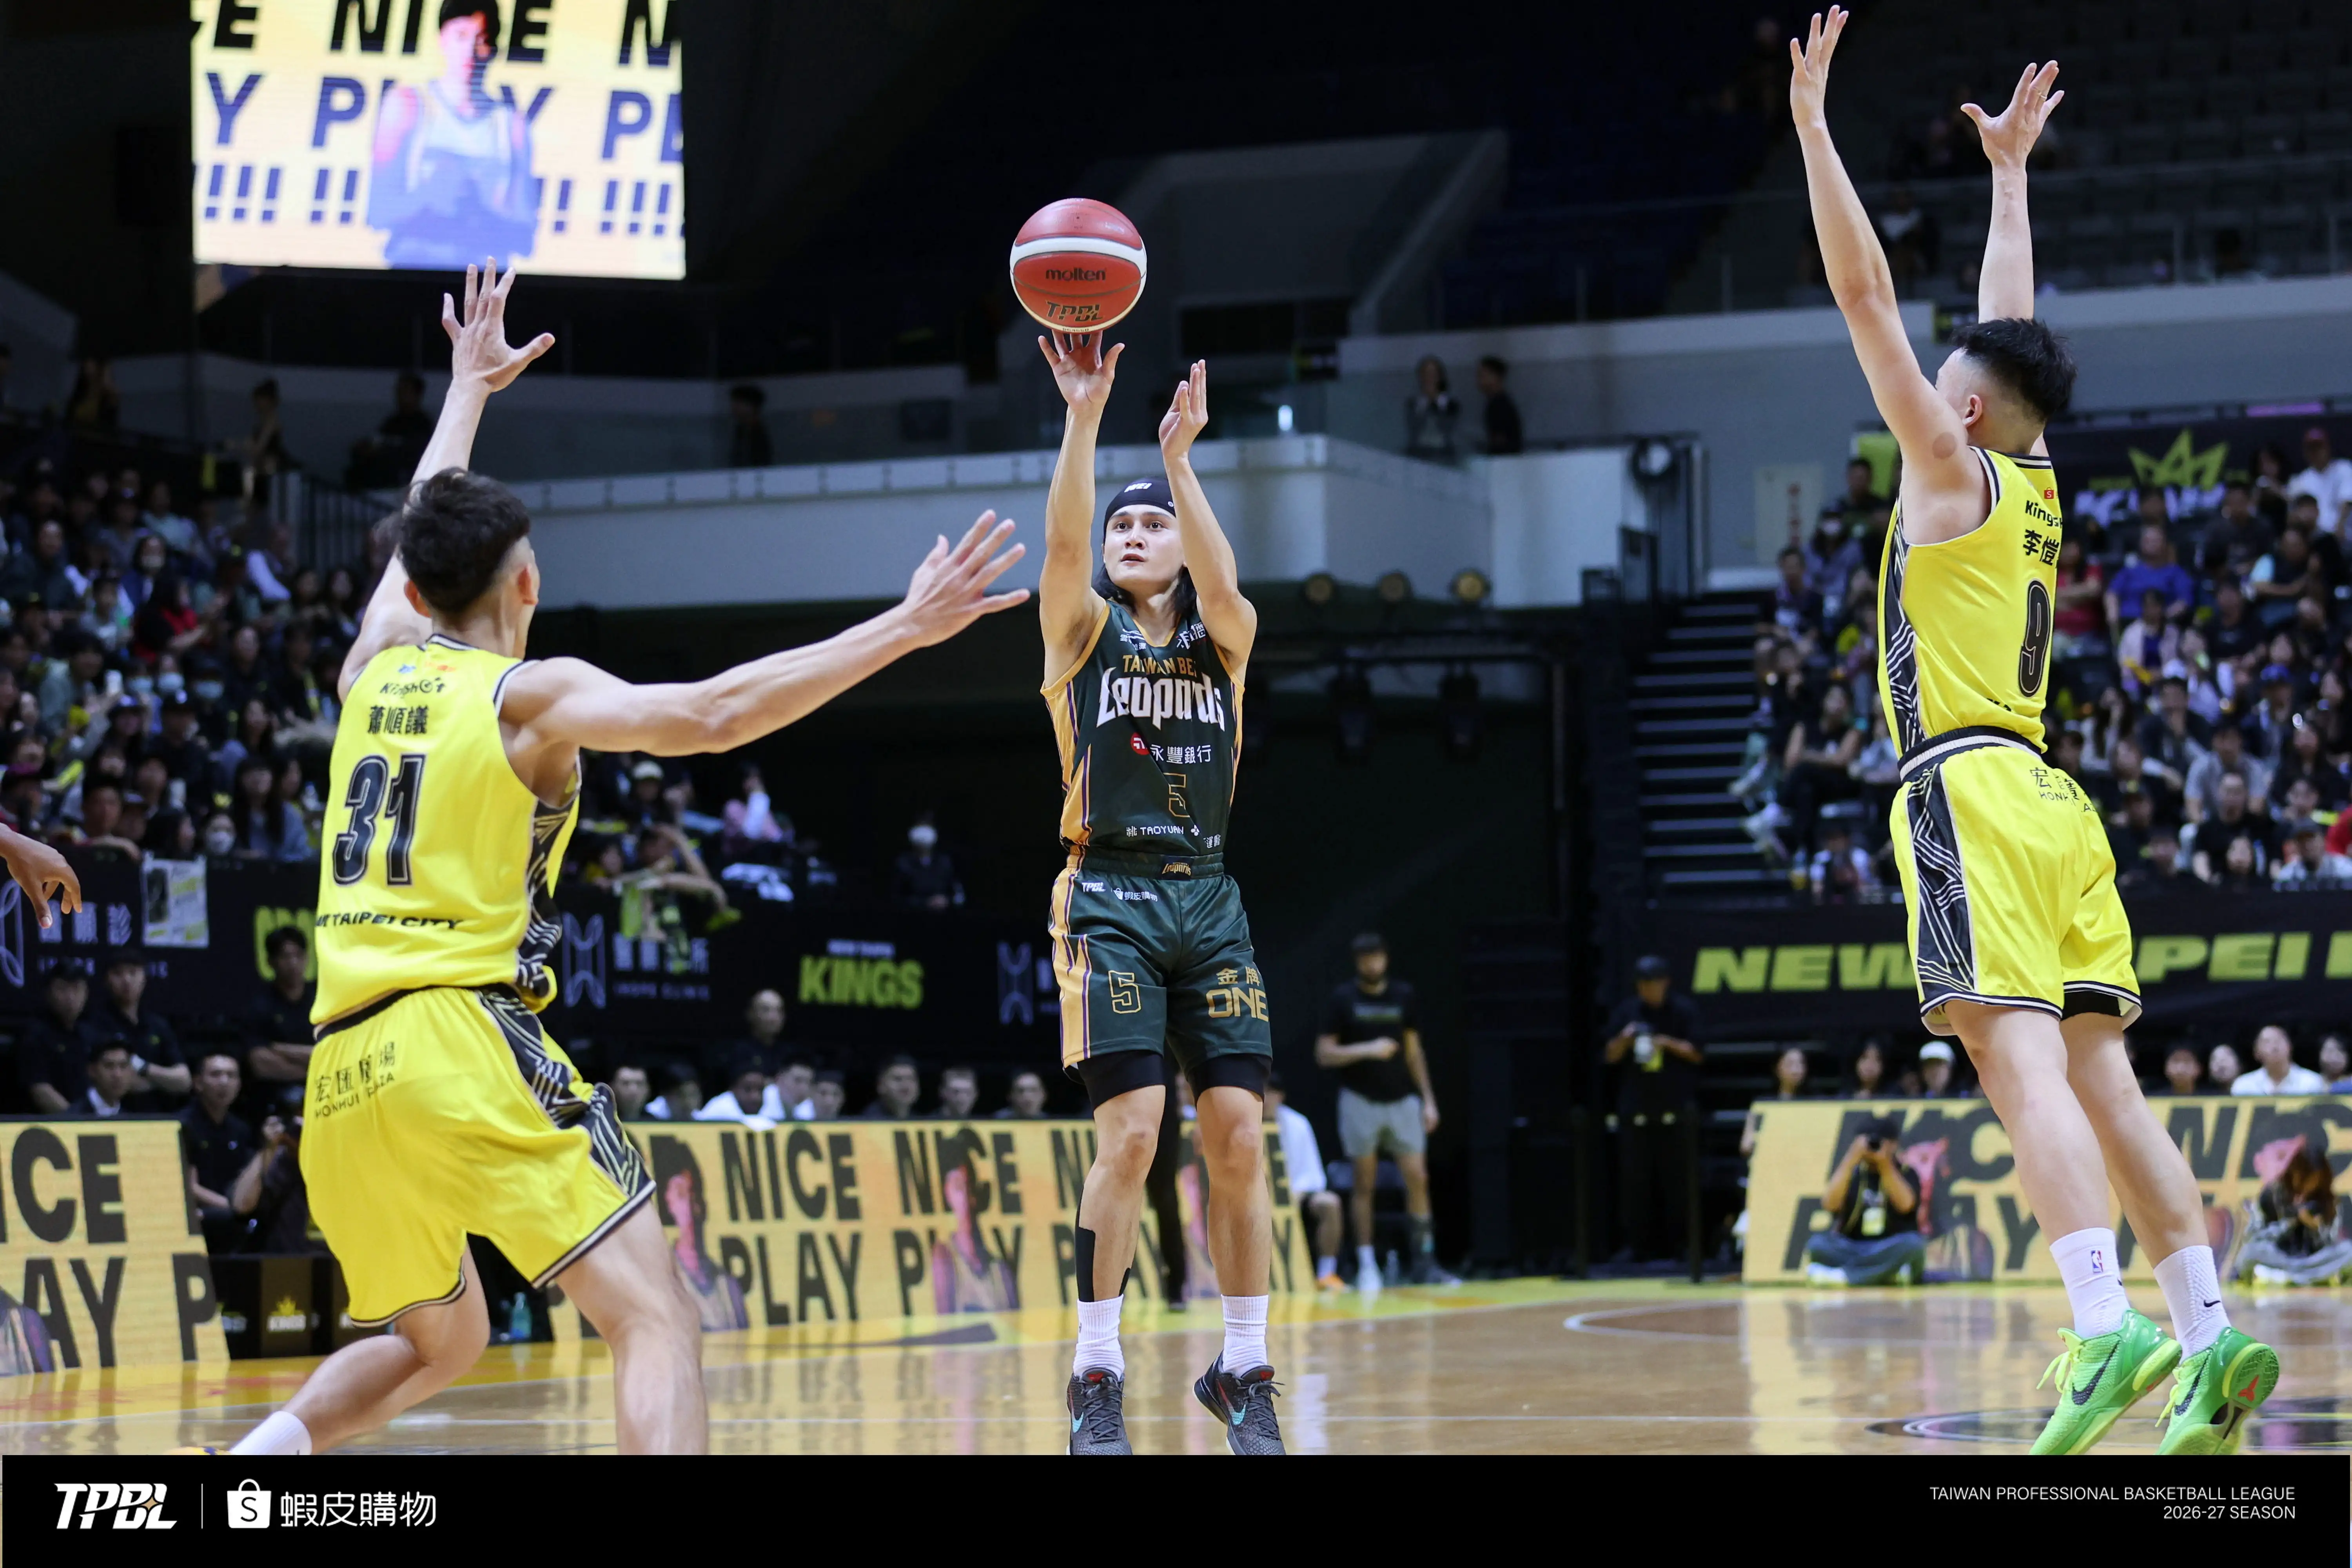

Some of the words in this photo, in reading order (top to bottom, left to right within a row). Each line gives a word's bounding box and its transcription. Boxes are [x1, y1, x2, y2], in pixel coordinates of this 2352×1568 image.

[1045, 267, 1107, 282] molten
[1045, 300, 1103, 322] TPBL
[2023, 529, 2060, 566] 李愷
[2018, 578, 2052, 698] 9
[1150, 744, 1211, 764] 永豐銀行
[1163, 772, 1191, 818] 5
[332, 753, 427, 887] 31
[1140, 826, 1184, 836] TAOYUAN
[1082, 882, 1106, 893] TPBL
[1124, 891, 1158, 902] 蝦皮購物
[332, 911, 397, 926] TAIPEI
[401, 916, 464, 930] CITY
[800, 955, 924, 1009] KINGS
[1216, 965, 1261, 987] 金牌
[1691, 943, 1918, 993] NEW
[1108, 970, 1142, 1014] 5
[1206, 987, 1269, 1022] ONE
[0, 1126, 127, 1244] CE
[720, 1129, 862, 1221] NICE
[720, 1232, 862, 1326] PLAY
[893, 1225, 1022, 1316] PY
